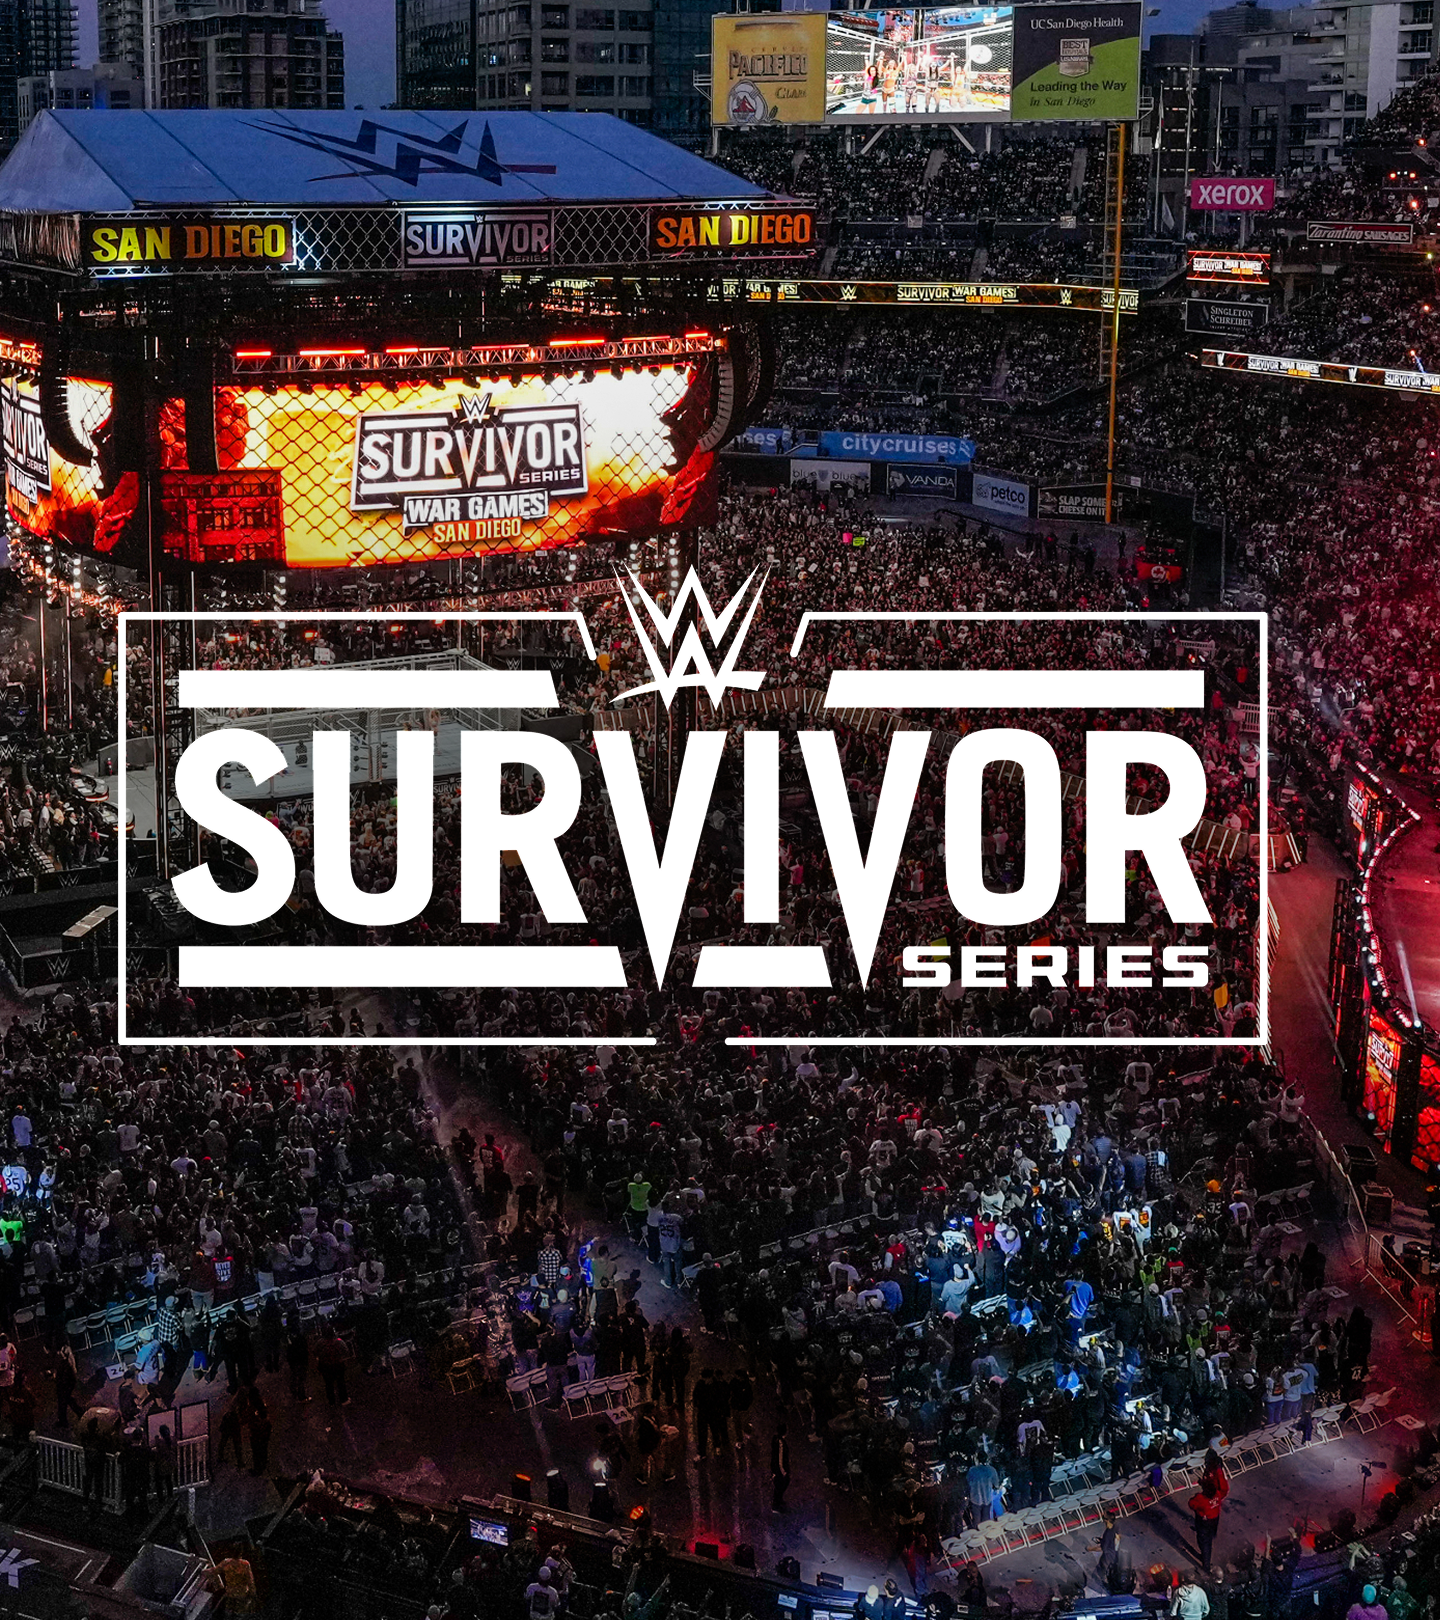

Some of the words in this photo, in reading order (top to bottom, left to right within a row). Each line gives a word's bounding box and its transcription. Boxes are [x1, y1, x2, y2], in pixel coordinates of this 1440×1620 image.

[1030, 19, 1046, 30] UC
[1047, 18, 1065, 30] San
[1066, 18, 1092, 30] Diego
[1093, 17, 1124, 28] Health
[1062, 41, 1087, 49] BEST
[1030, 82, 1077, 92] Leading
[1080, 82, 1099, 91] the
[1102, 80, 1127, 92] Way
[1030, 97, 1040, 107] in
[1044, 97, 1063, 107] San
[1067, 96, 1096, 108] Diego
[1198, 184, 1265, 206] xerox
[657, 214, 720, 248] SAN
[728, 213, 812, 246] DIEGO
[1309, 223, 1362, 240] Tarantino
[1364, 230, 1410, 241] SAUSAGES
[91, 226, 172, 262] SAN
[183, 224, 286, 259] DIEGO
[406, 222, 548, 266] SURVIVOR
[506, 255, 549, 263] SERIES
[897, 286, 949, 300] SURVIVOR
[954, 287, 977, 297] WAR
[979, 287, 1015, 298] GAMES
[981, 296, 1003, 304] DIEGO
[1210, 305, 1254, 318] SINGLETON
[1248, 357, 1279, 370] SURVIVOR
[1384, 373, 1421, 387] SURVIVOR
[842, 434, 957, 455] citycruises
[361, 421, 580, 488] SURVIVOR
[26, 457, 48, 476] SERIES
[519, 468, 581, 484] SERIES
[792, 469, 818, 479] blue
[831, 469, 855, 480] blue
[905, 474, 955, 487] VANDA
[991, 484, 1026, 504] petco
[408, 498, 460, 524] WAR
[468, 493, 545, 520] GAMES
[1058, 495, 1081, 506] SLAP
[1081, 496, 1107, 508] SOME
[1058, 506, 1085, 515] CHEESE
[1085, 507, 1098, 515] ON
[1098, 508, 1106, 516] IT
[433, 523, 470, 543] SAN
[475, 519, 522, 539] DIEGO
